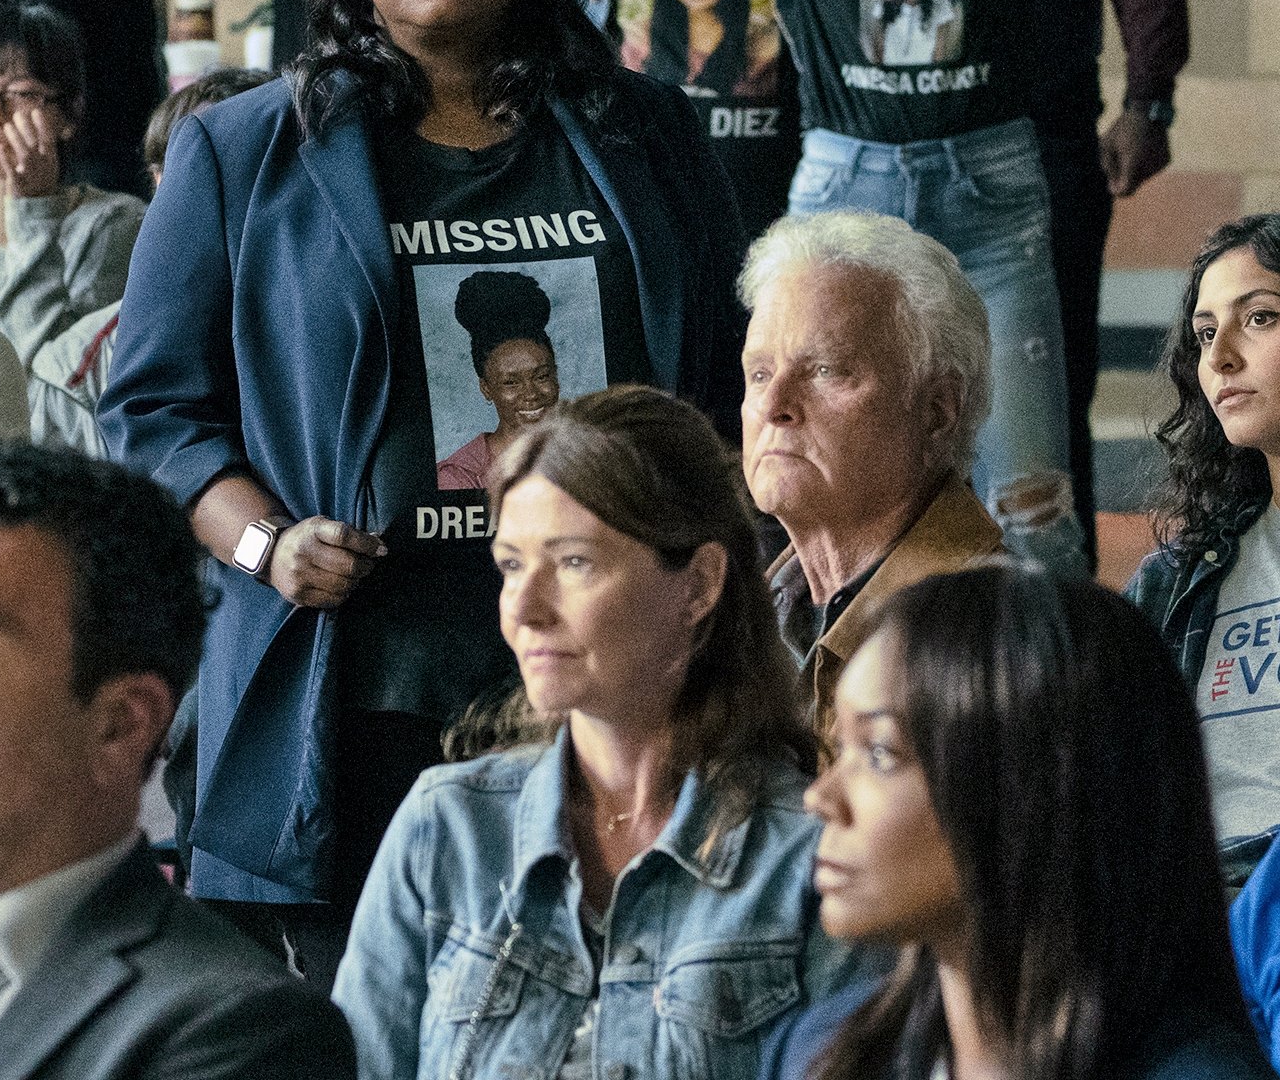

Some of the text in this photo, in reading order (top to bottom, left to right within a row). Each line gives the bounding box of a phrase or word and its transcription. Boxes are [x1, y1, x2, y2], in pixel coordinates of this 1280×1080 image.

[709, 107, 780, 138] DIEZ
[389, 209, 607, 255] MISSING
[1212, 658, 1236, 702] THE
